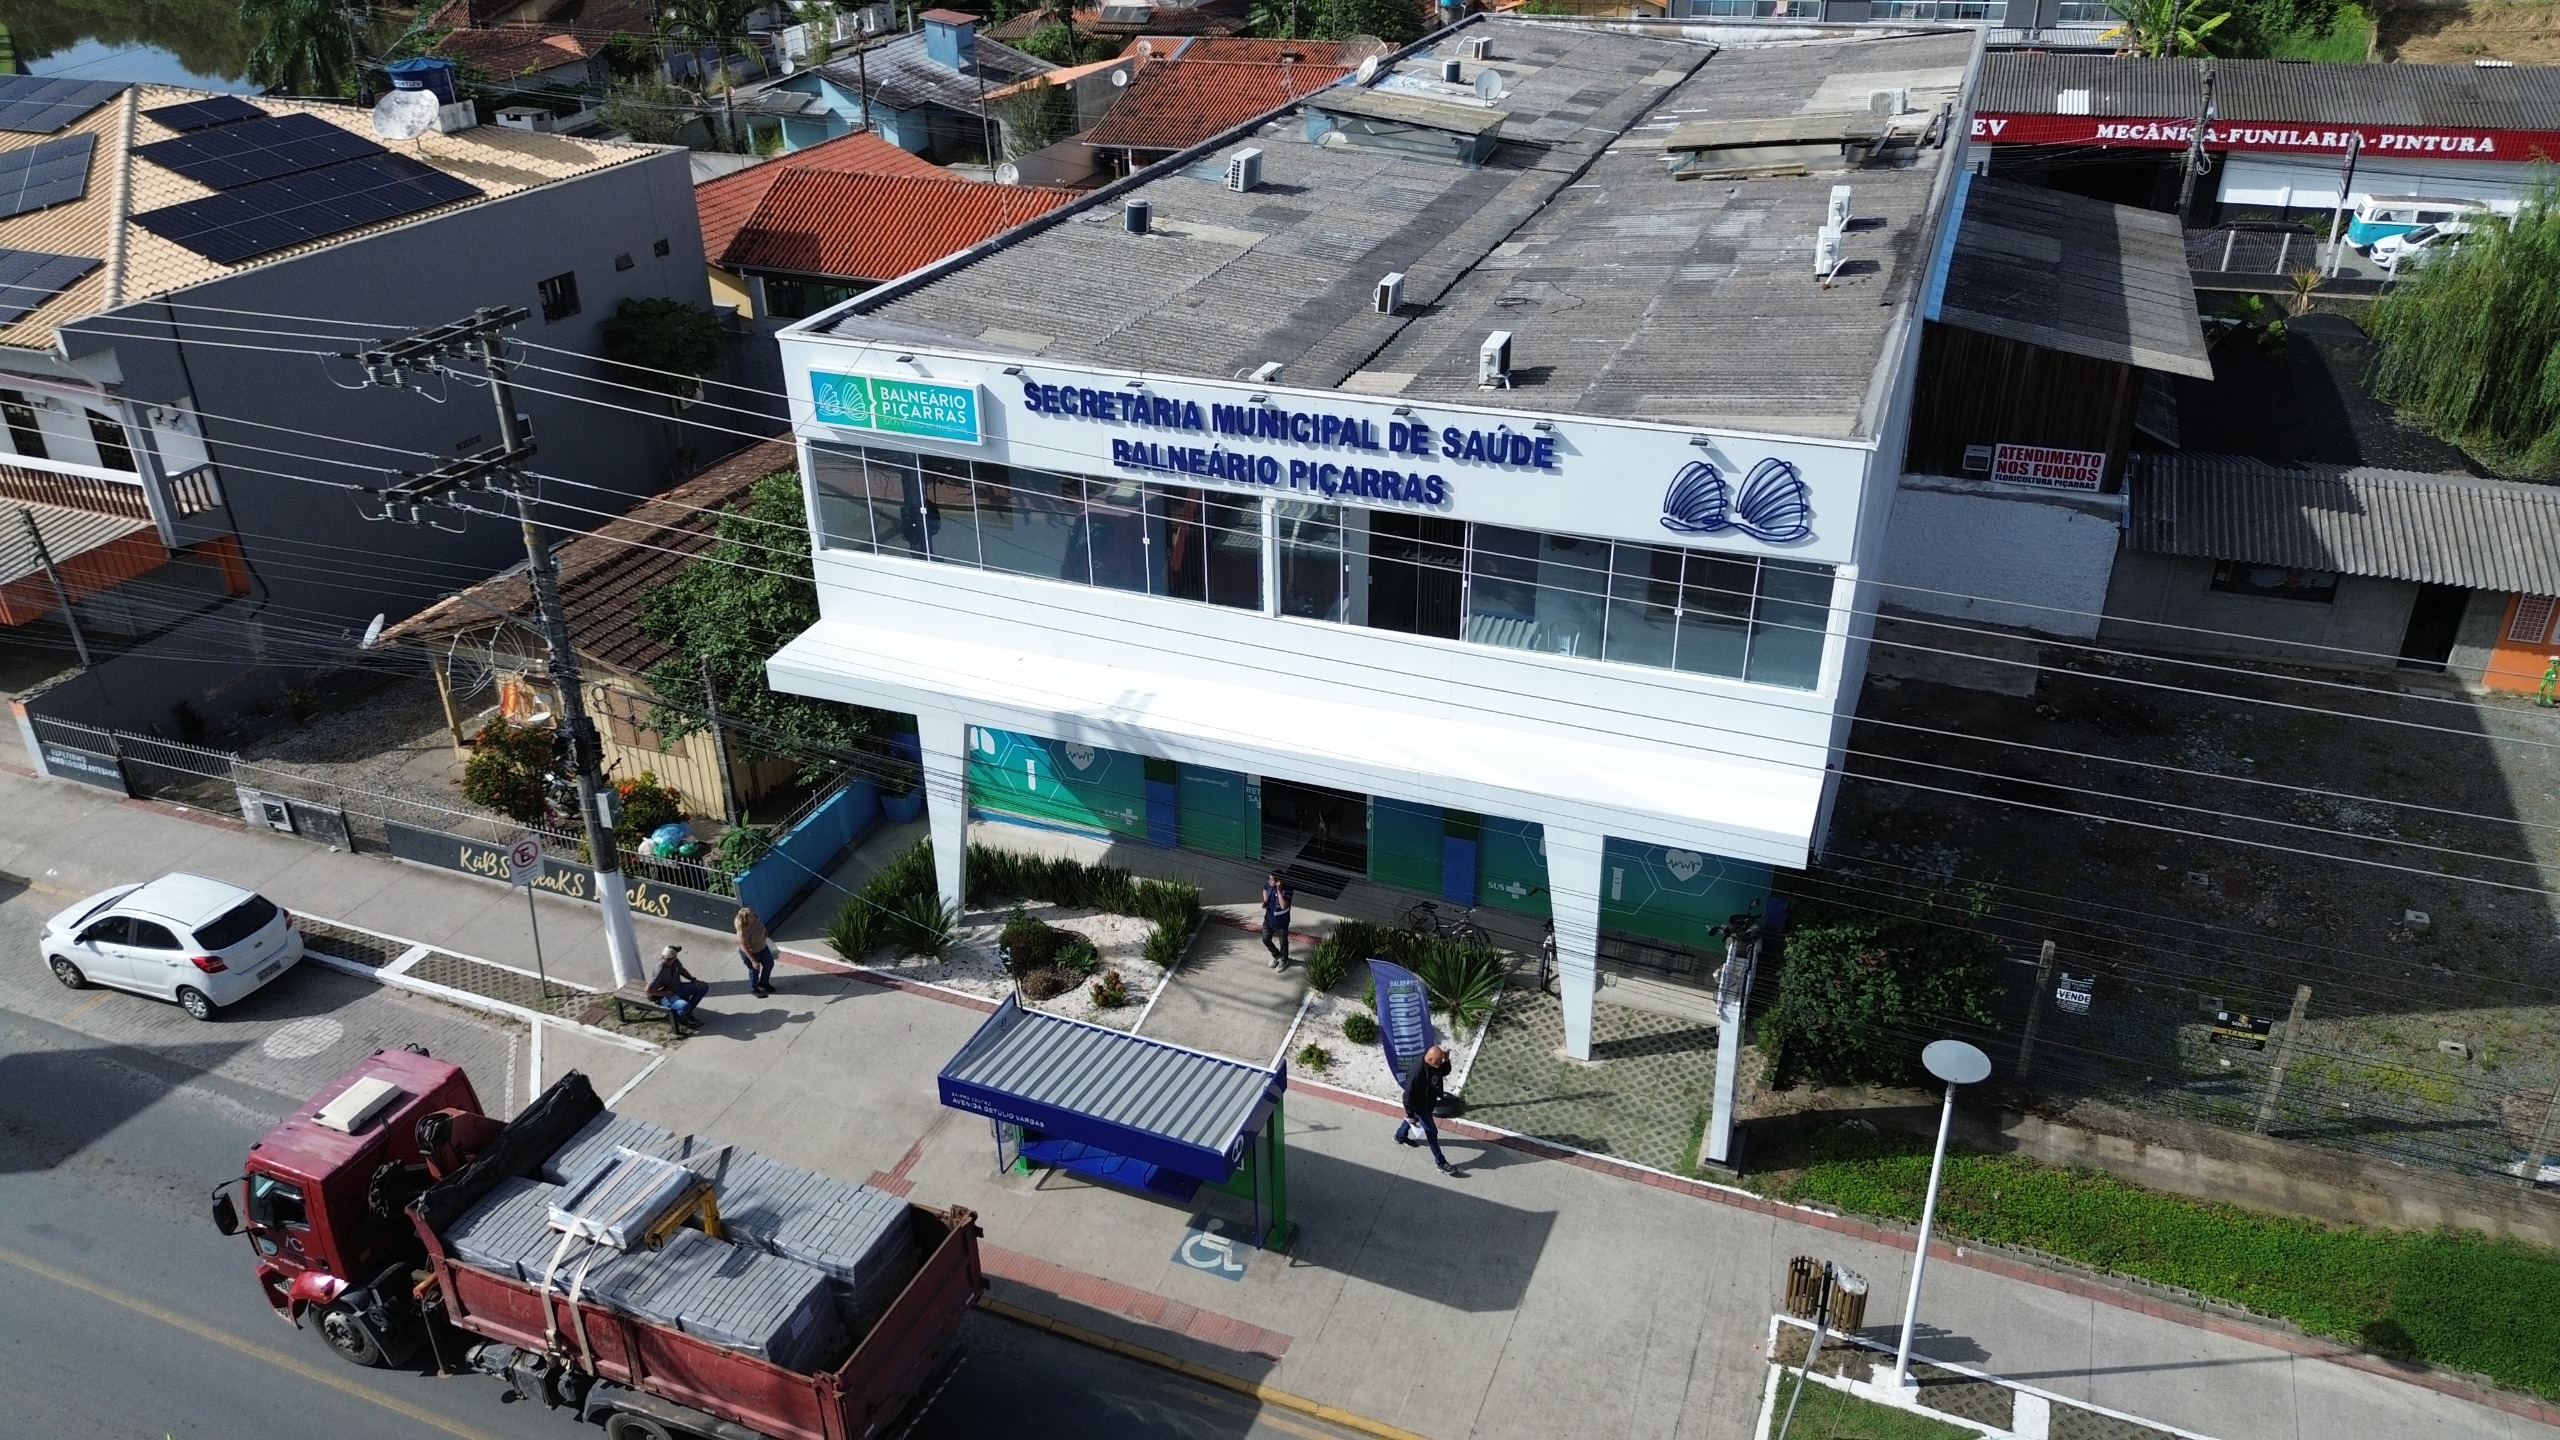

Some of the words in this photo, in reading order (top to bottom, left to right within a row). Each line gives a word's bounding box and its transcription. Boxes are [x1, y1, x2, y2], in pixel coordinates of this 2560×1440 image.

[880, 387, 966, 409] BALNEÁRIO
[882, 402, 966, 424] PIÇARRAS
[1023, 382, 1203, 431] SECRETARIA
[1212, 403, 1378, 450] MUNICIPAL
[1389, 421, 1429, 455] DE
[1442, 424, 1554, 469] SAÚDE
[1998, 446, 2102, 468] ATENDIMENTO
[1112, 438, 1278, 485] BALNEÁRIO
[1289, 459, 1444, 504] PIÇARRAS
[1994, 473, 2052, 486] FLORICULTURA
[2054, 479, 2096, 490] PIÇARRAS
[1996, 460, 2030, 475] NOS
[2033, 463, 2098, 482] FUNDOS
[1488, 881, 1505, 891] SUS
[2060, 990, 2091, 1003] VENDE
[1388, 992, 1425, 1056] GIGANTE!
[2231, 1021, 2252, 1029] SOUZA
[953, 1097, 982, 1110] AVENIDA
[1015, 1114, 1045, 1128] VARGAS
